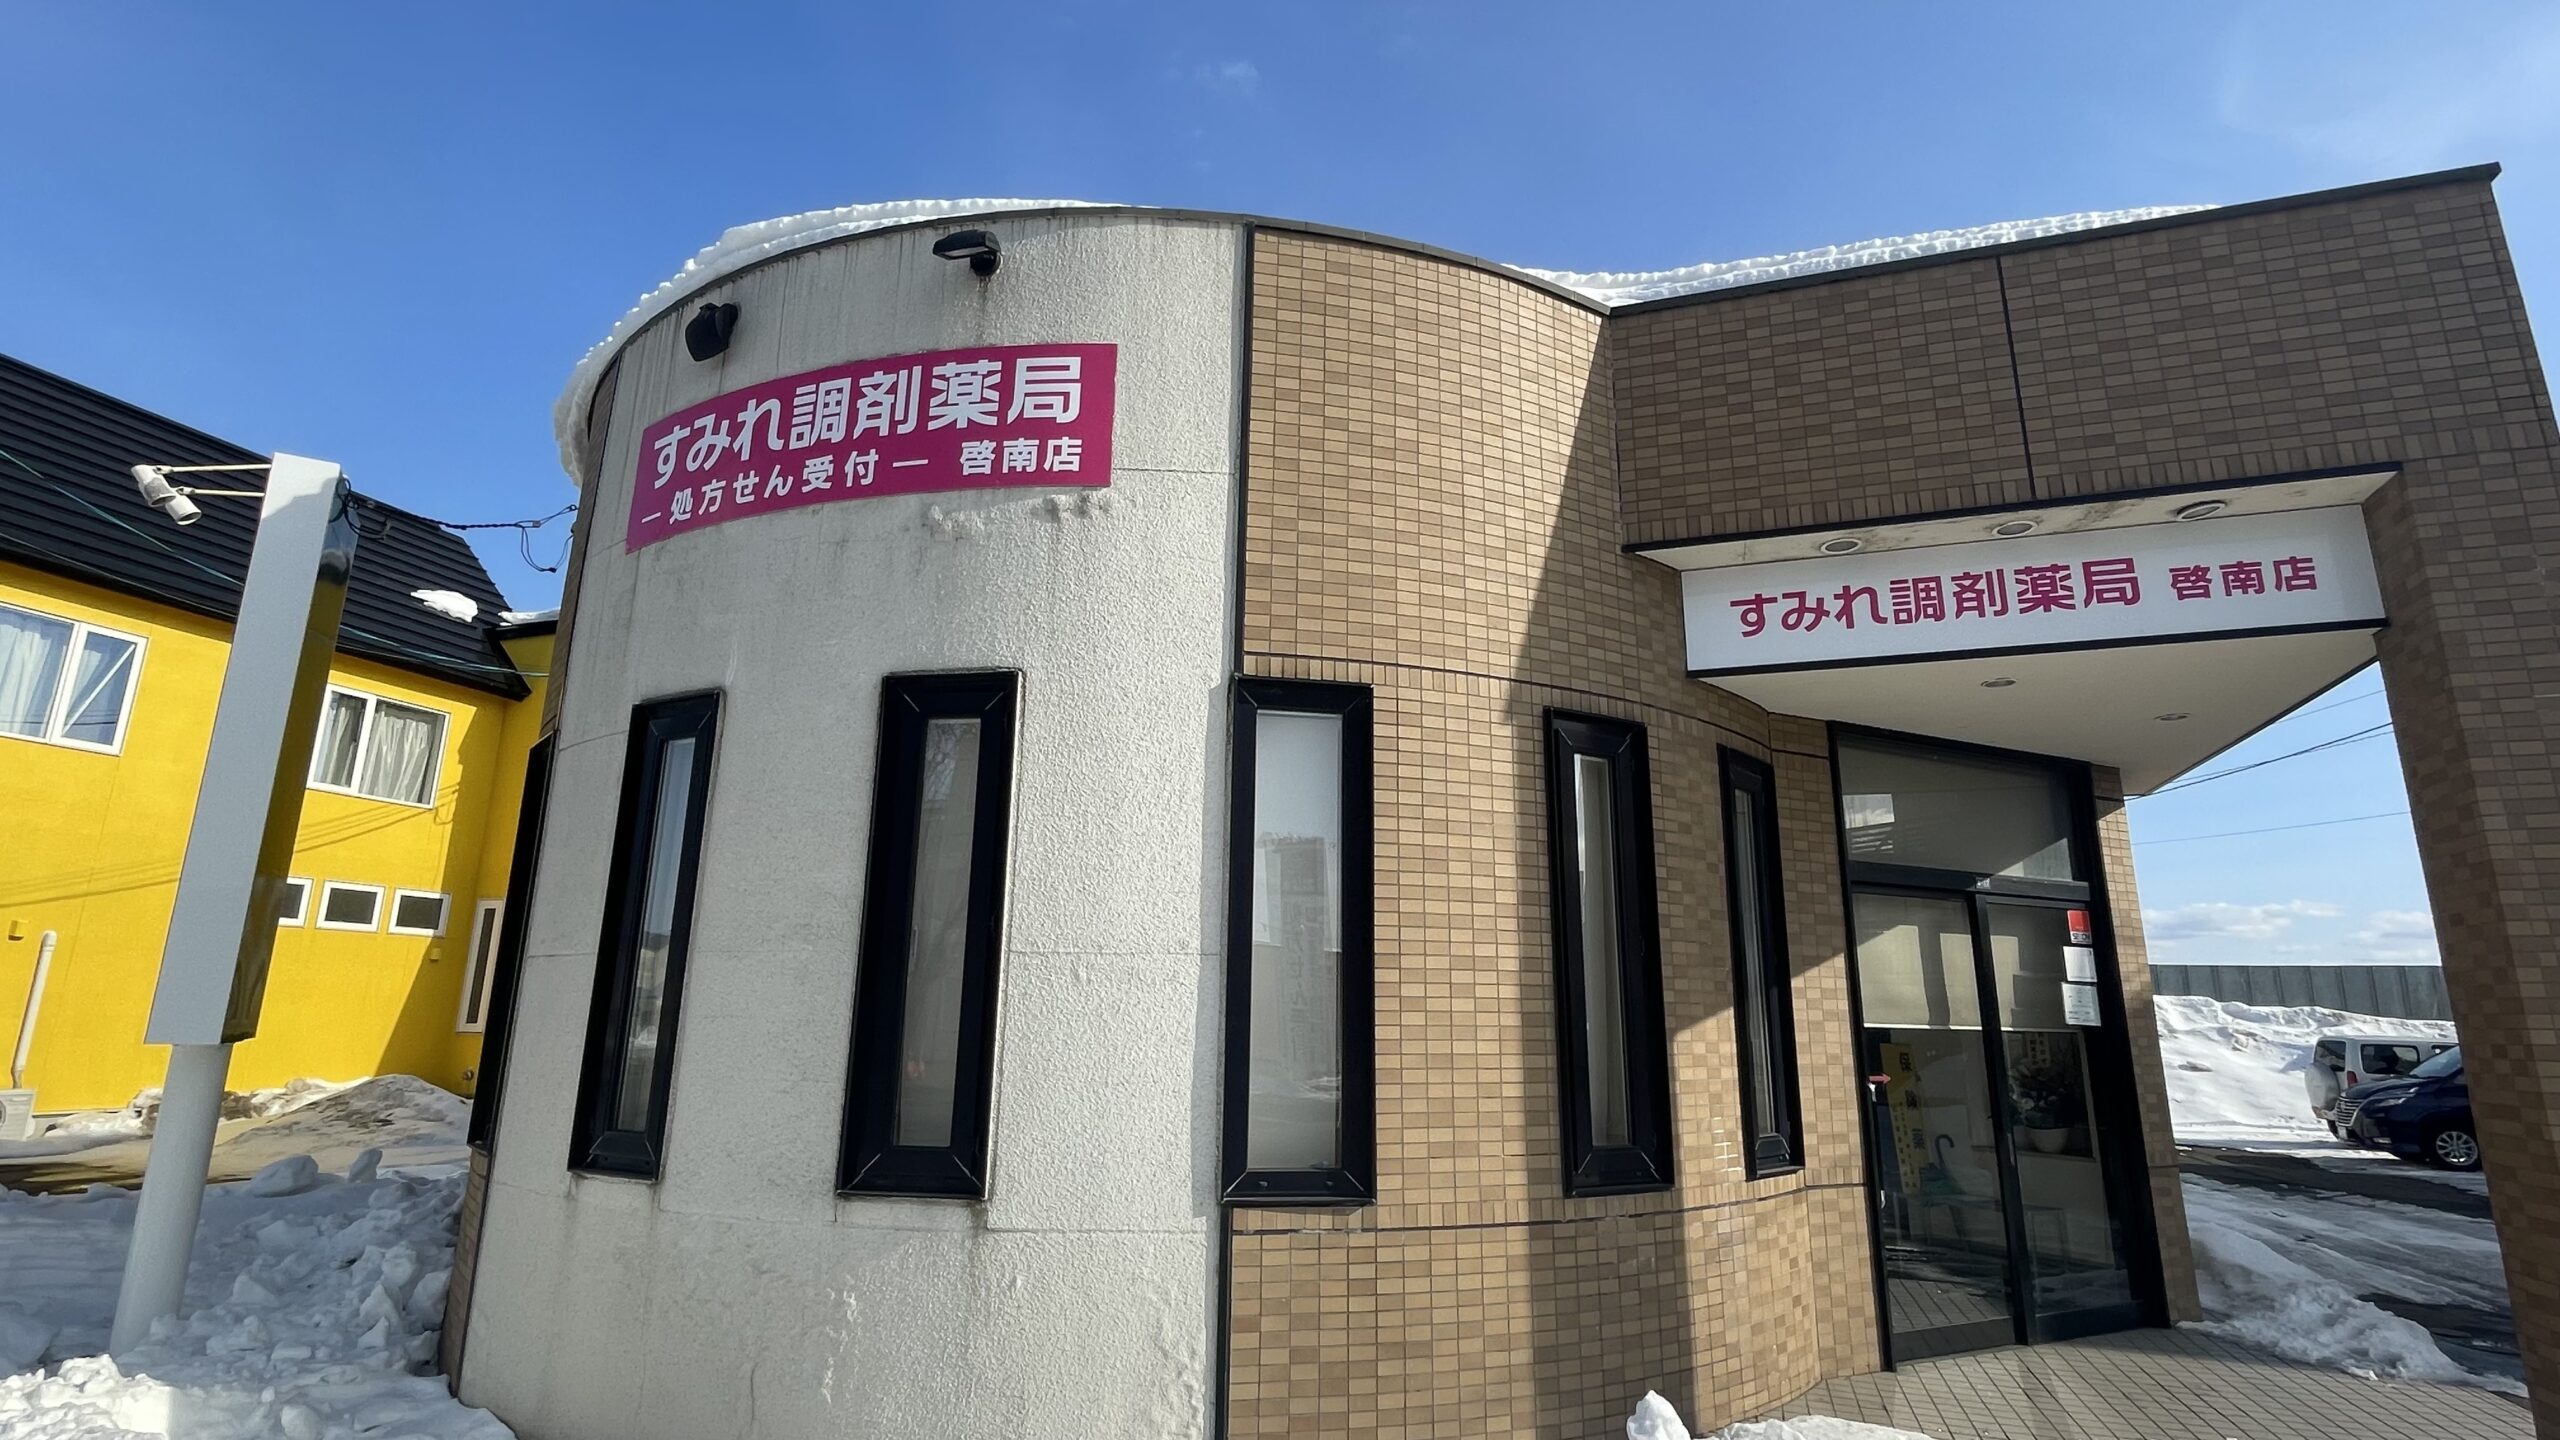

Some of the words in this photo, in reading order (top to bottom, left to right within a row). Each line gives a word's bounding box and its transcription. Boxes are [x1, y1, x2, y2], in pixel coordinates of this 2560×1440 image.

[655, 357, 1082, 489] すみれ調剤薬局
[959, 437, 1083, 475] 啓南店
[1730, 557, 2141, 637] すみれ調剤薬局
[2169, 556, 2317, 601] 啓南店
